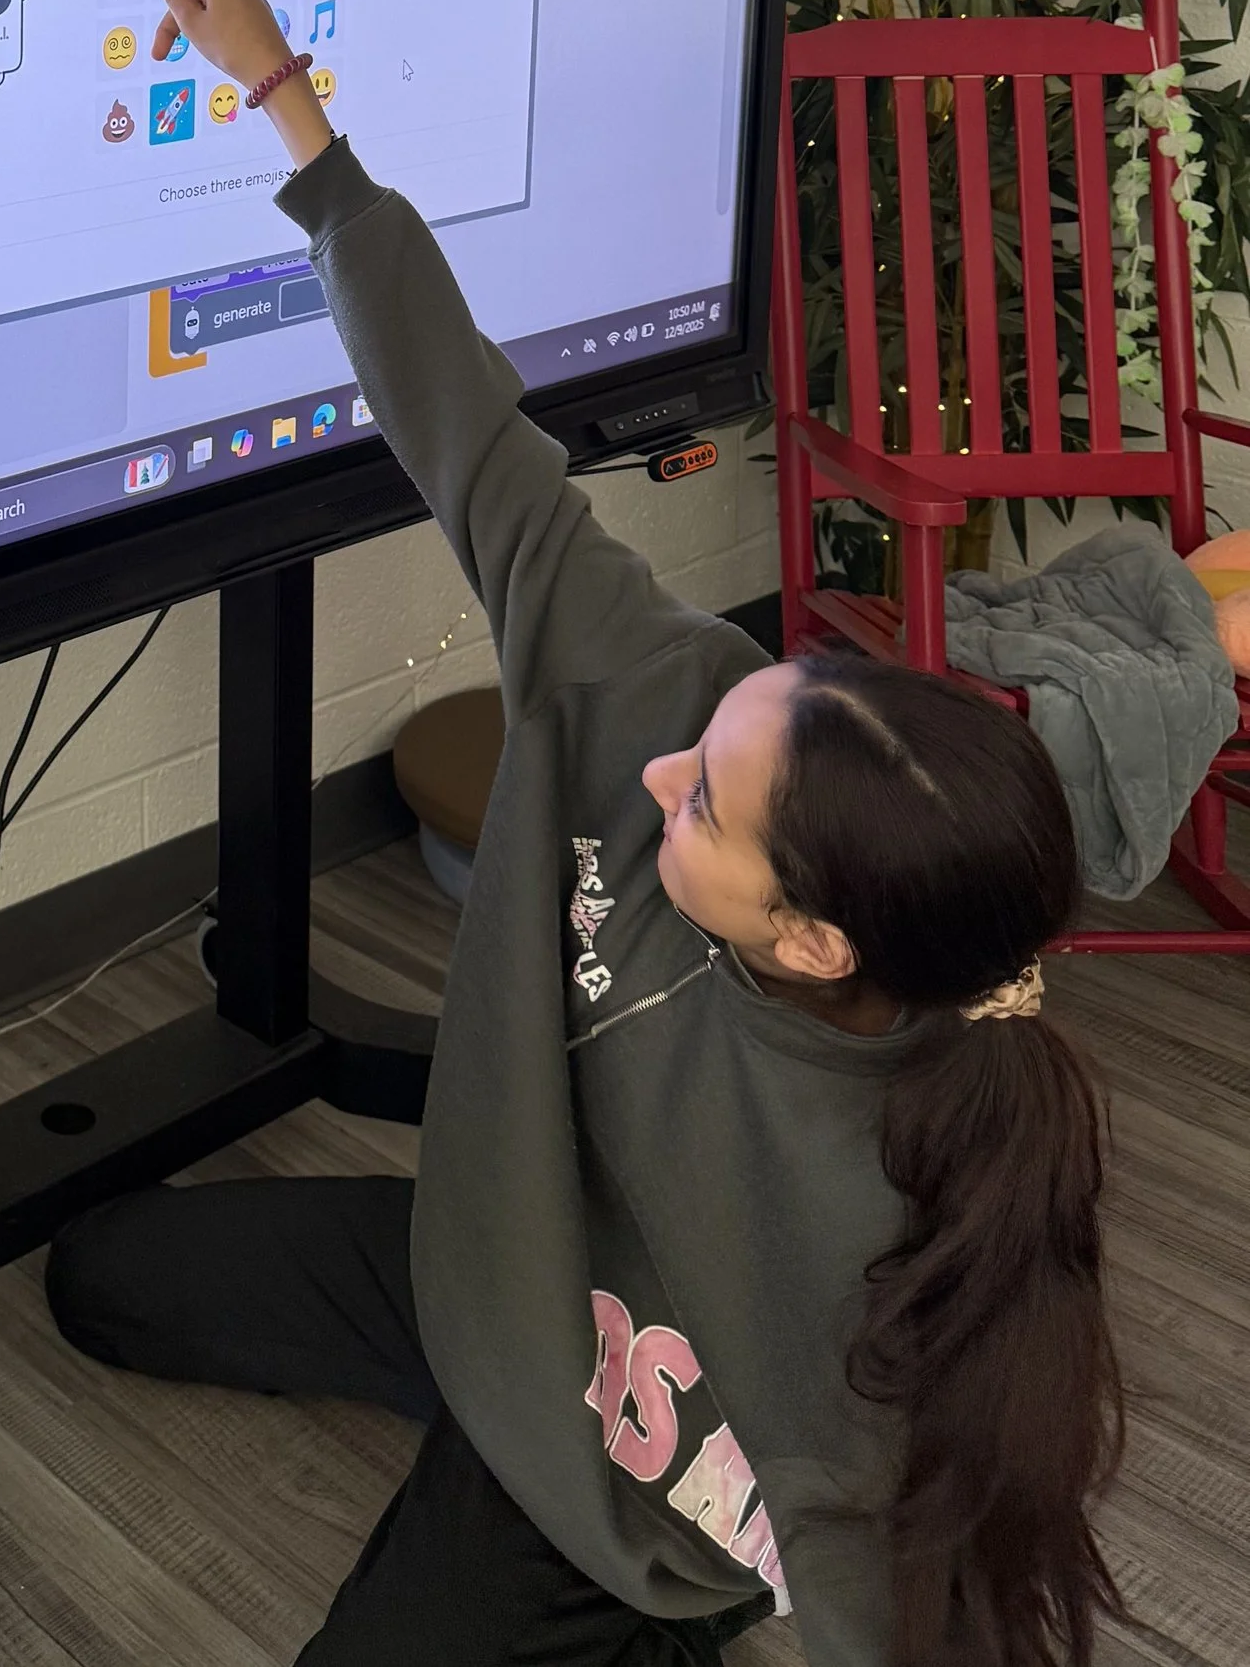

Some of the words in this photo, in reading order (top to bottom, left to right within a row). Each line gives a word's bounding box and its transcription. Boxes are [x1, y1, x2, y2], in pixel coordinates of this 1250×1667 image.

[159, 183, 208, 203] Choose
[210, 176, 243, 193] three
[213, 298, 272, 329] generate
[691, 300, 706, 315] AM
[664, 318, 705, 340] 12/9/2025
